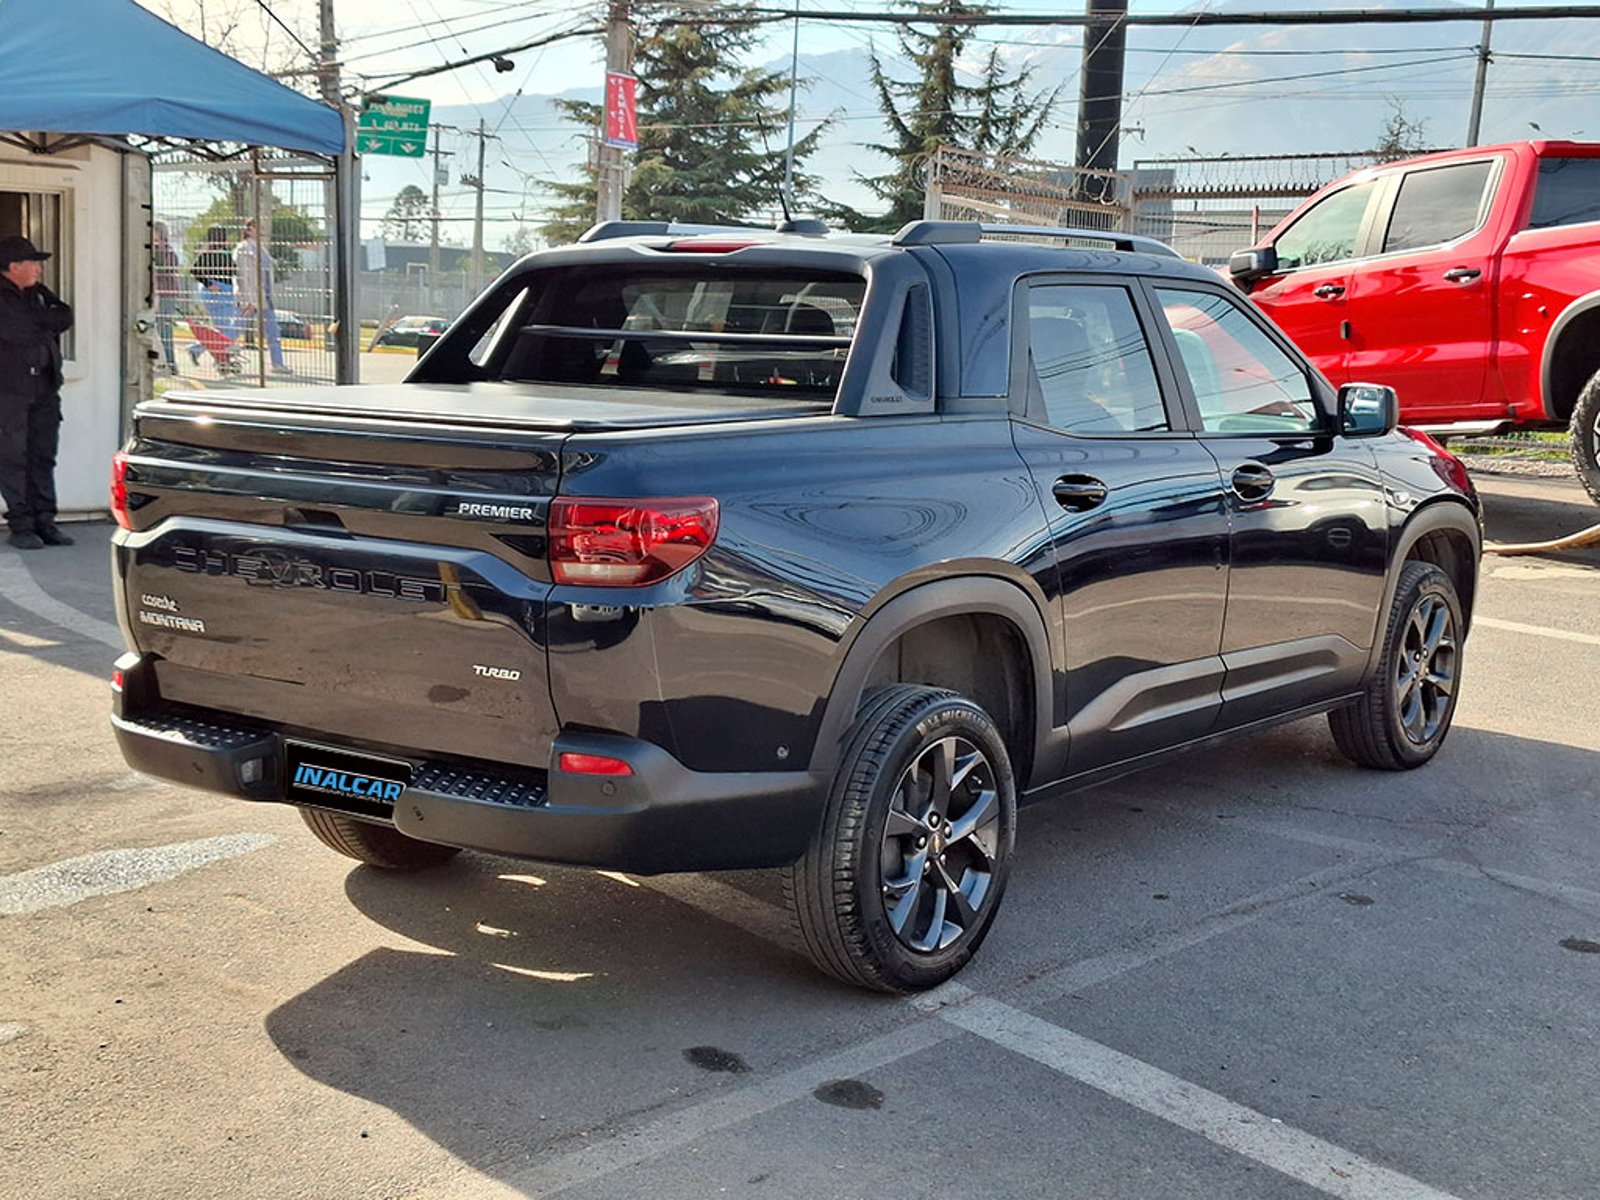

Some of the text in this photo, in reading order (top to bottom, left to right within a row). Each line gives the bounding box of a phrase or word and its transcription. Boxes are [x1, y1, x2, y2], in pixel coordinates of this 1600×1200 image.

[458, 502, 533, 520] PREMIER
[172, 546, 449, 606] CHEVROLET
[140, 610, 205, 633] MONTANA
[472, 664, 521, 681] TURBO
